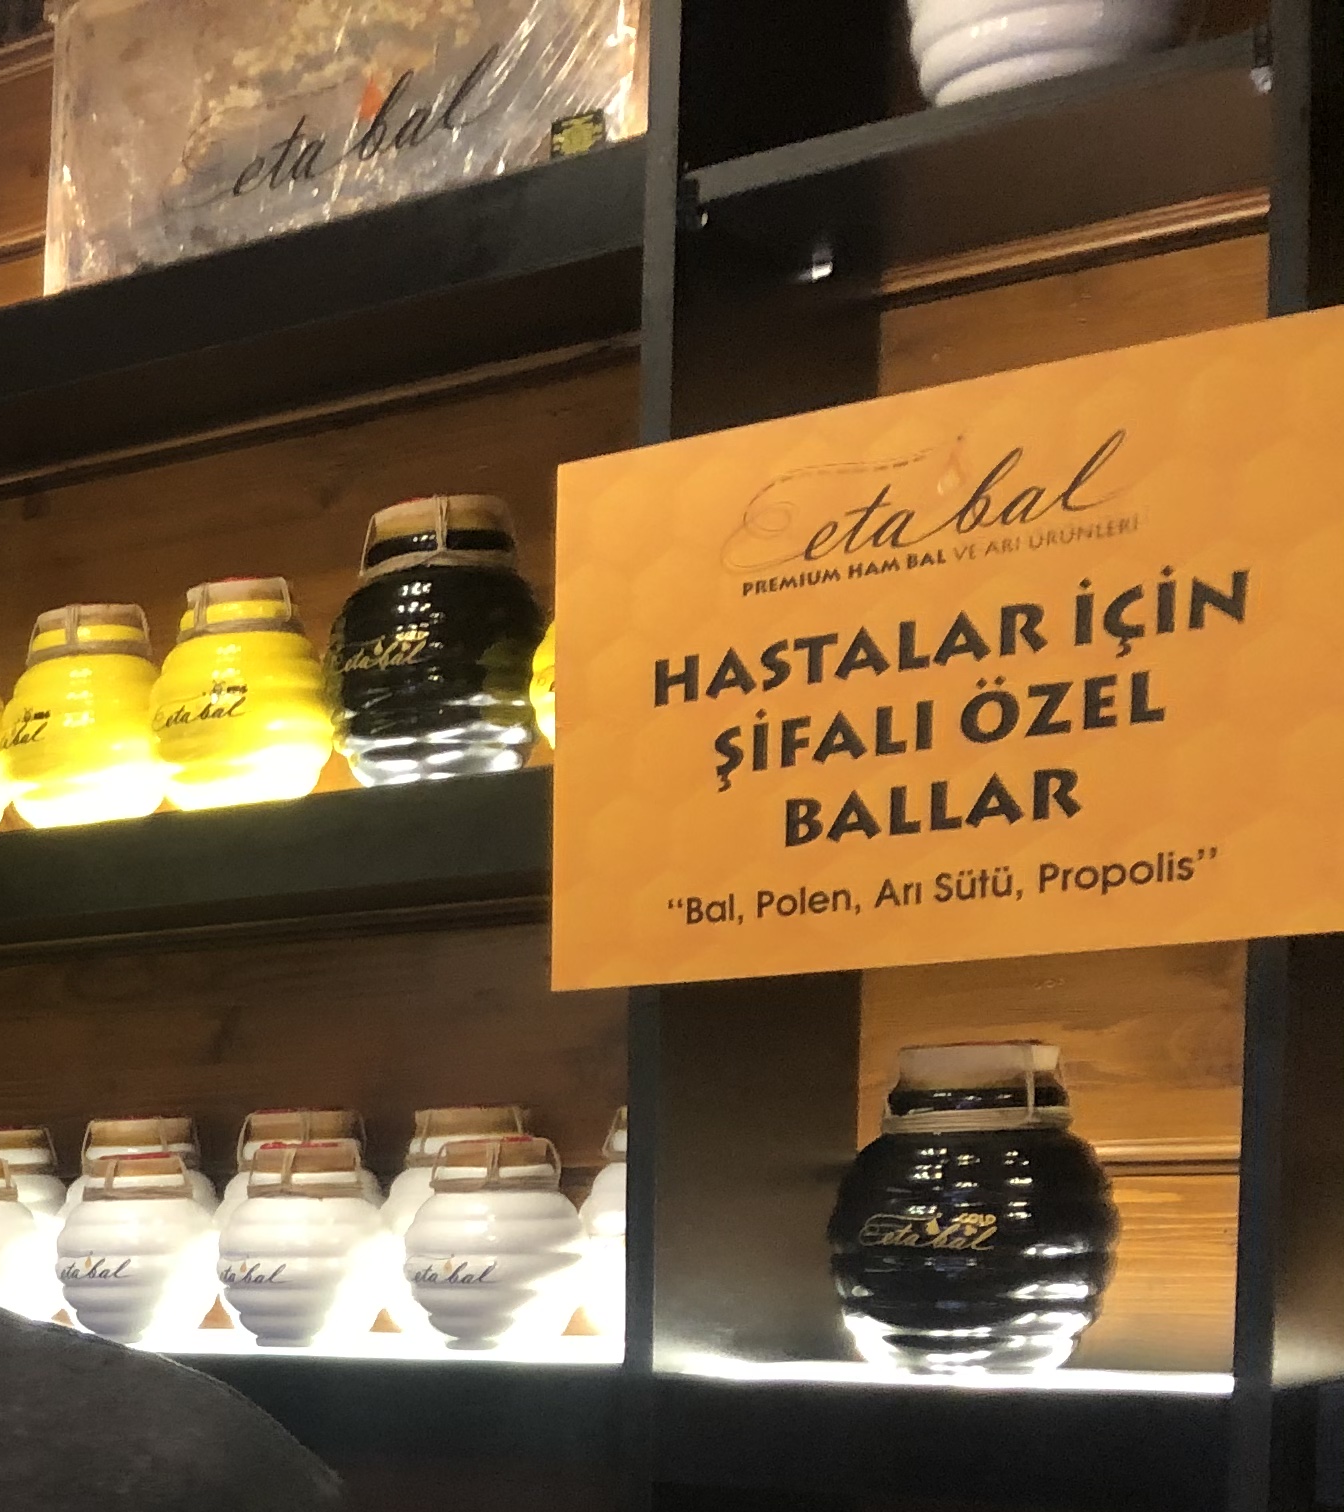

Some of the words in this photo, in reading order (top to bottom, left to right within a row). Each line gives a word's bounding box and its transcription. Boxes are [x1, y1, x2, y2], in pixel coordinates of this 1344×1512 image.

[742, 567, 842, 597] PREMIUM
[847, 559, 901, 580] HAM
[906, 548, 947, 568] BAL
[952, 542, 977, 562] VE
[984, 536, 1021, 557] ARI
[653, 602, 1050, 708] HASTALAR
[1074, 564, 1250, 657] İÇİN
[713, 708, 935, 793] ŞİFALI
[959, 668, 1166, 743] ÖZEL
[783, 766, 1085, 848] BALLAR
[755, 883, 862, 920] Polen,
[873, 879, 923, 910] Arı
[933, 868, 1025, 904] Sütü,
